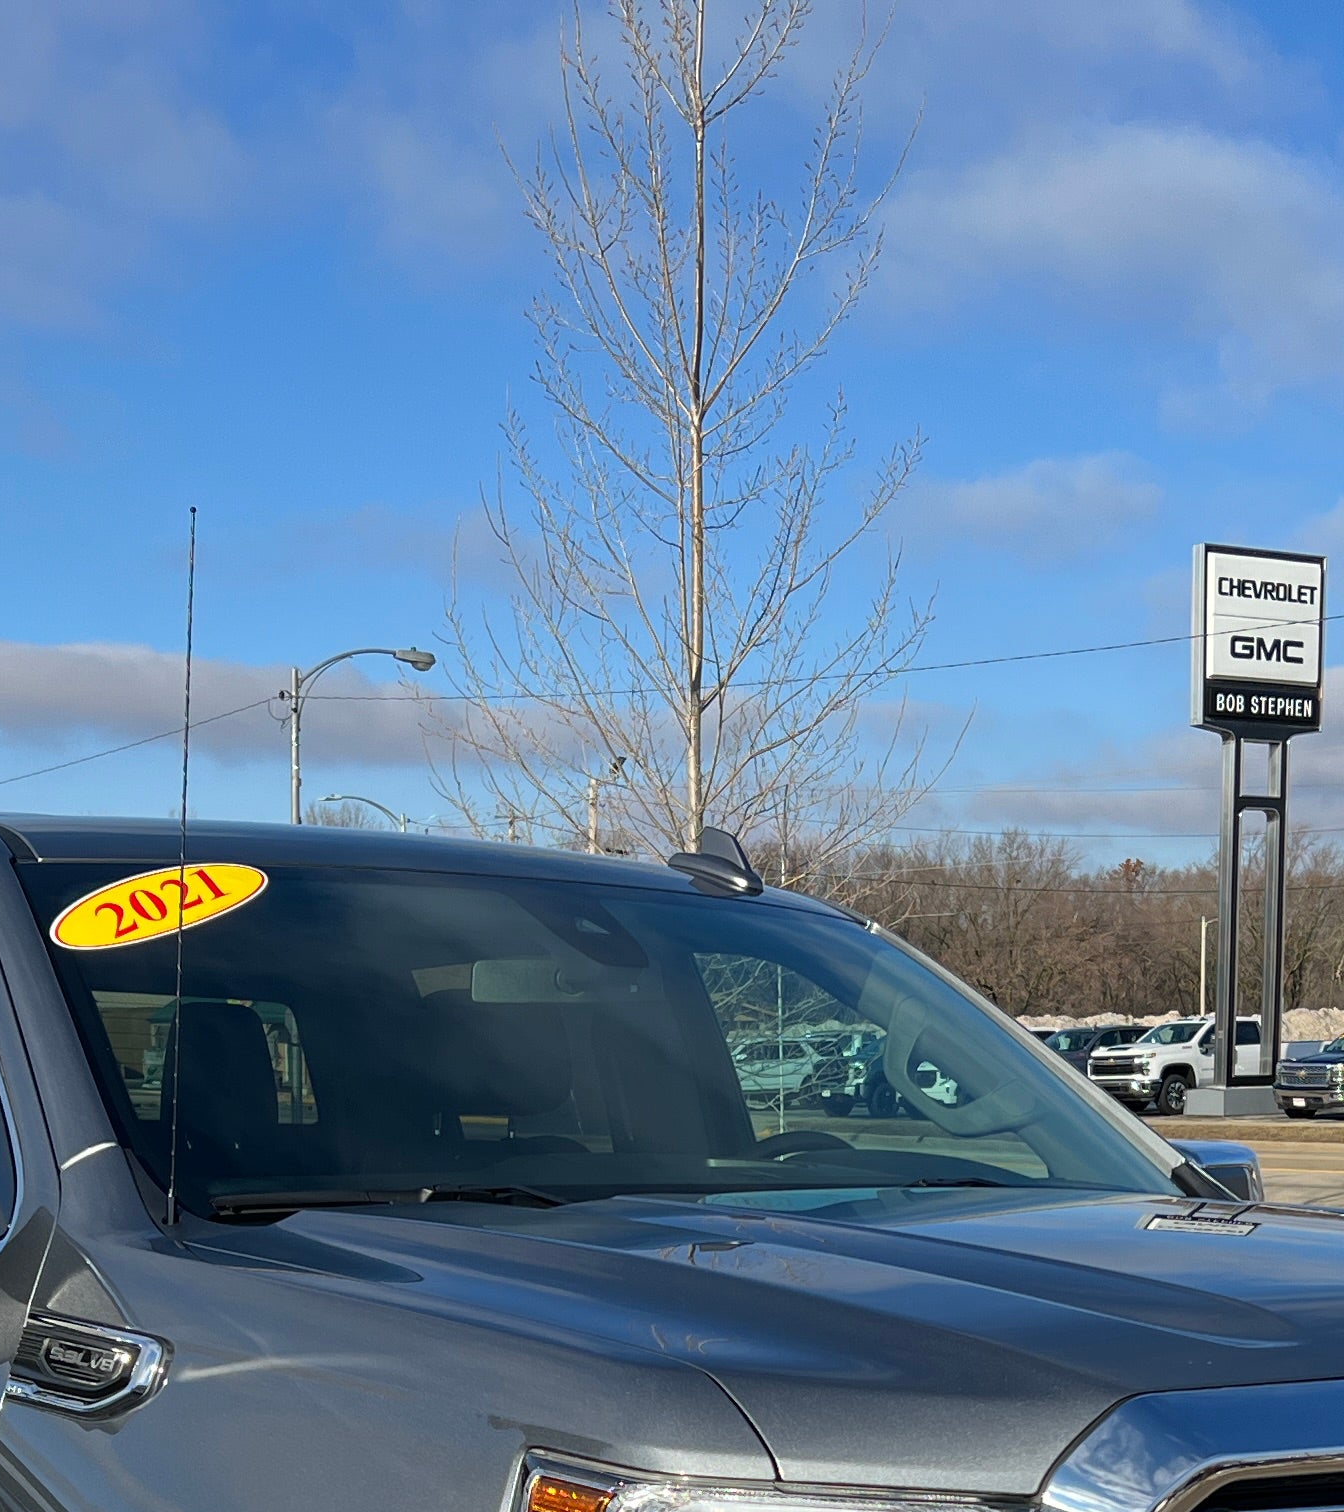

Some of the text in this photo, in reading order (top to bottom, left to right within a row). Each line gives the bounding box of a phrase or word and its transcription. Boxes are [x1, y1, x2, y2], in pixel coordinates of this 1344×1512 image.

[1217, 576, 1318, 605] CHEVROLET
[1230, 635, 1304, 664] GMC
[1216, 693, 1313, 718] BOB STEPHEN
[94, 868, 232, 939] 2021
